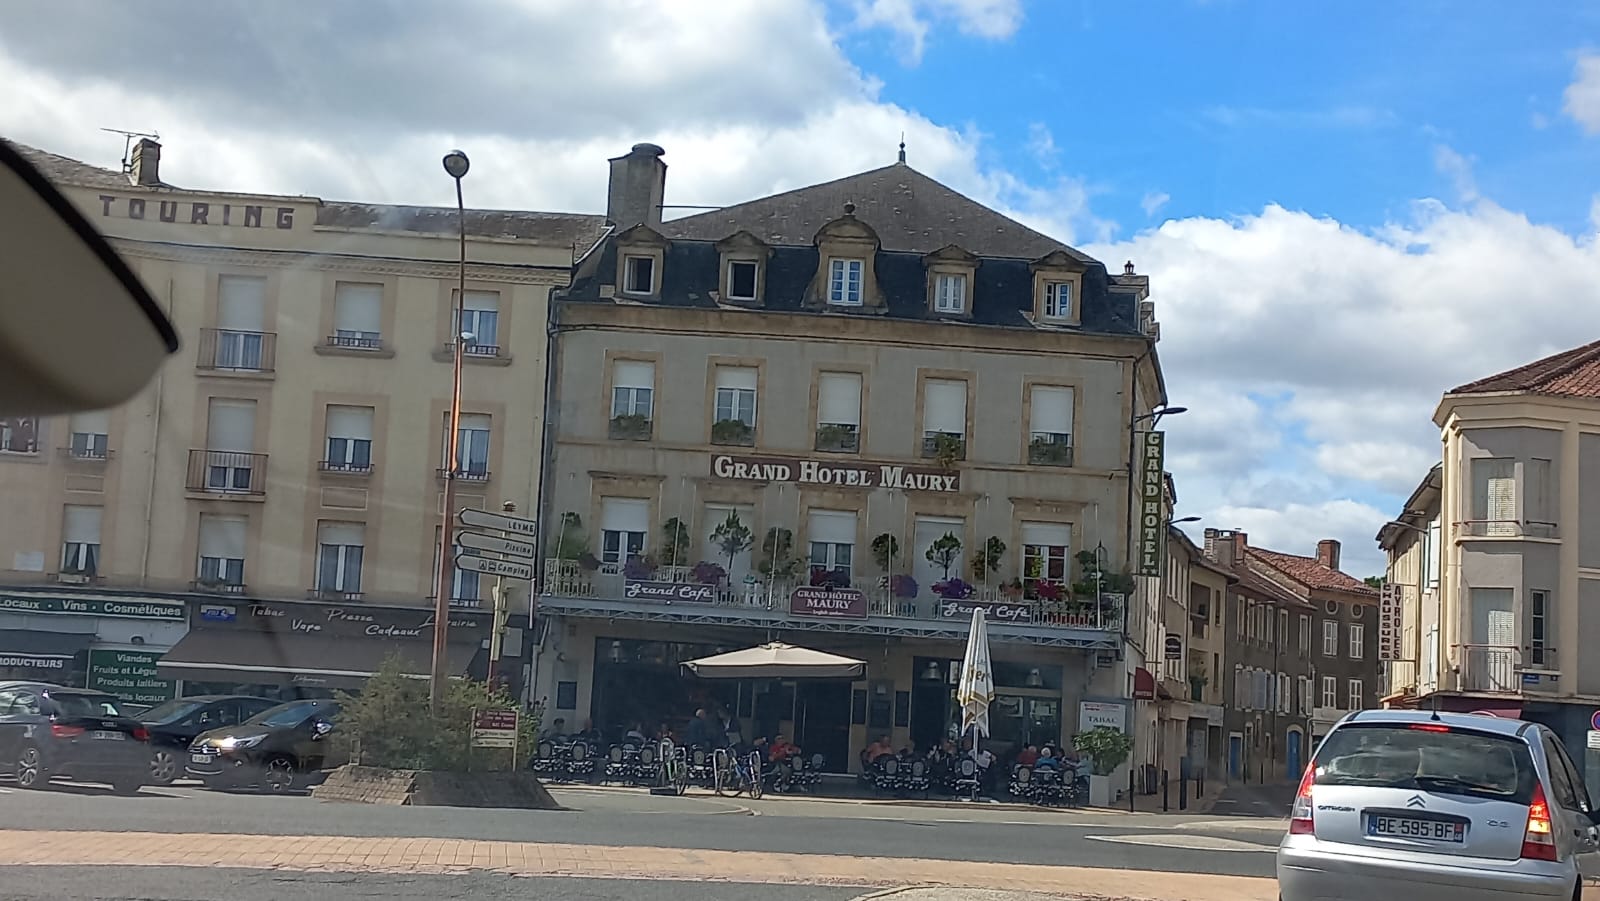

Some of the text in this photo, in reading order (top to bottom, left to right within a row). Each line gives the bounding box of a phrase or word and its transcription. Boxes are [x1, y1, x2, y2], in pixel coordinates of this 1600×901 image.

[99, 195, 294, 229] TOURING
[714, 455, 790, 481] GRAND
[879, 465, 957, 492] MAURY
[1144, 433, 1160, 566] GRAND HOTEL
[508, 520, 534, 532] LEYME
[504, 542, 531, 554] Piscine
[498, 563, 529, 577] Camping
[625, 583, 713, 600] Grand Café
[797, 590, 828, 599] GRAND
[62, 600, 88, 611] Vins
[103, 602, 182, 617] Cosmétiques
[248, 603, 286, 617] Tabac
[806, 599, 851, 609] MAURY
[941, 602, 1031, 620] Grad Café
[325, 607, 375, 622] Presse
[1380, 584, 1392, 659] CHAUSSURES
[292, 619, 321, 632] Vape
[1393, 585, 1402, 660] AYROLES
[365, 624, 422, 638] Cadeaux
[0, 657, 63, 668] ODUCTEURS
[117, 654, 152, 663] Viandes
[93, 665, 119, 674] Fruits
[97, 677, 135, 687] Produits
